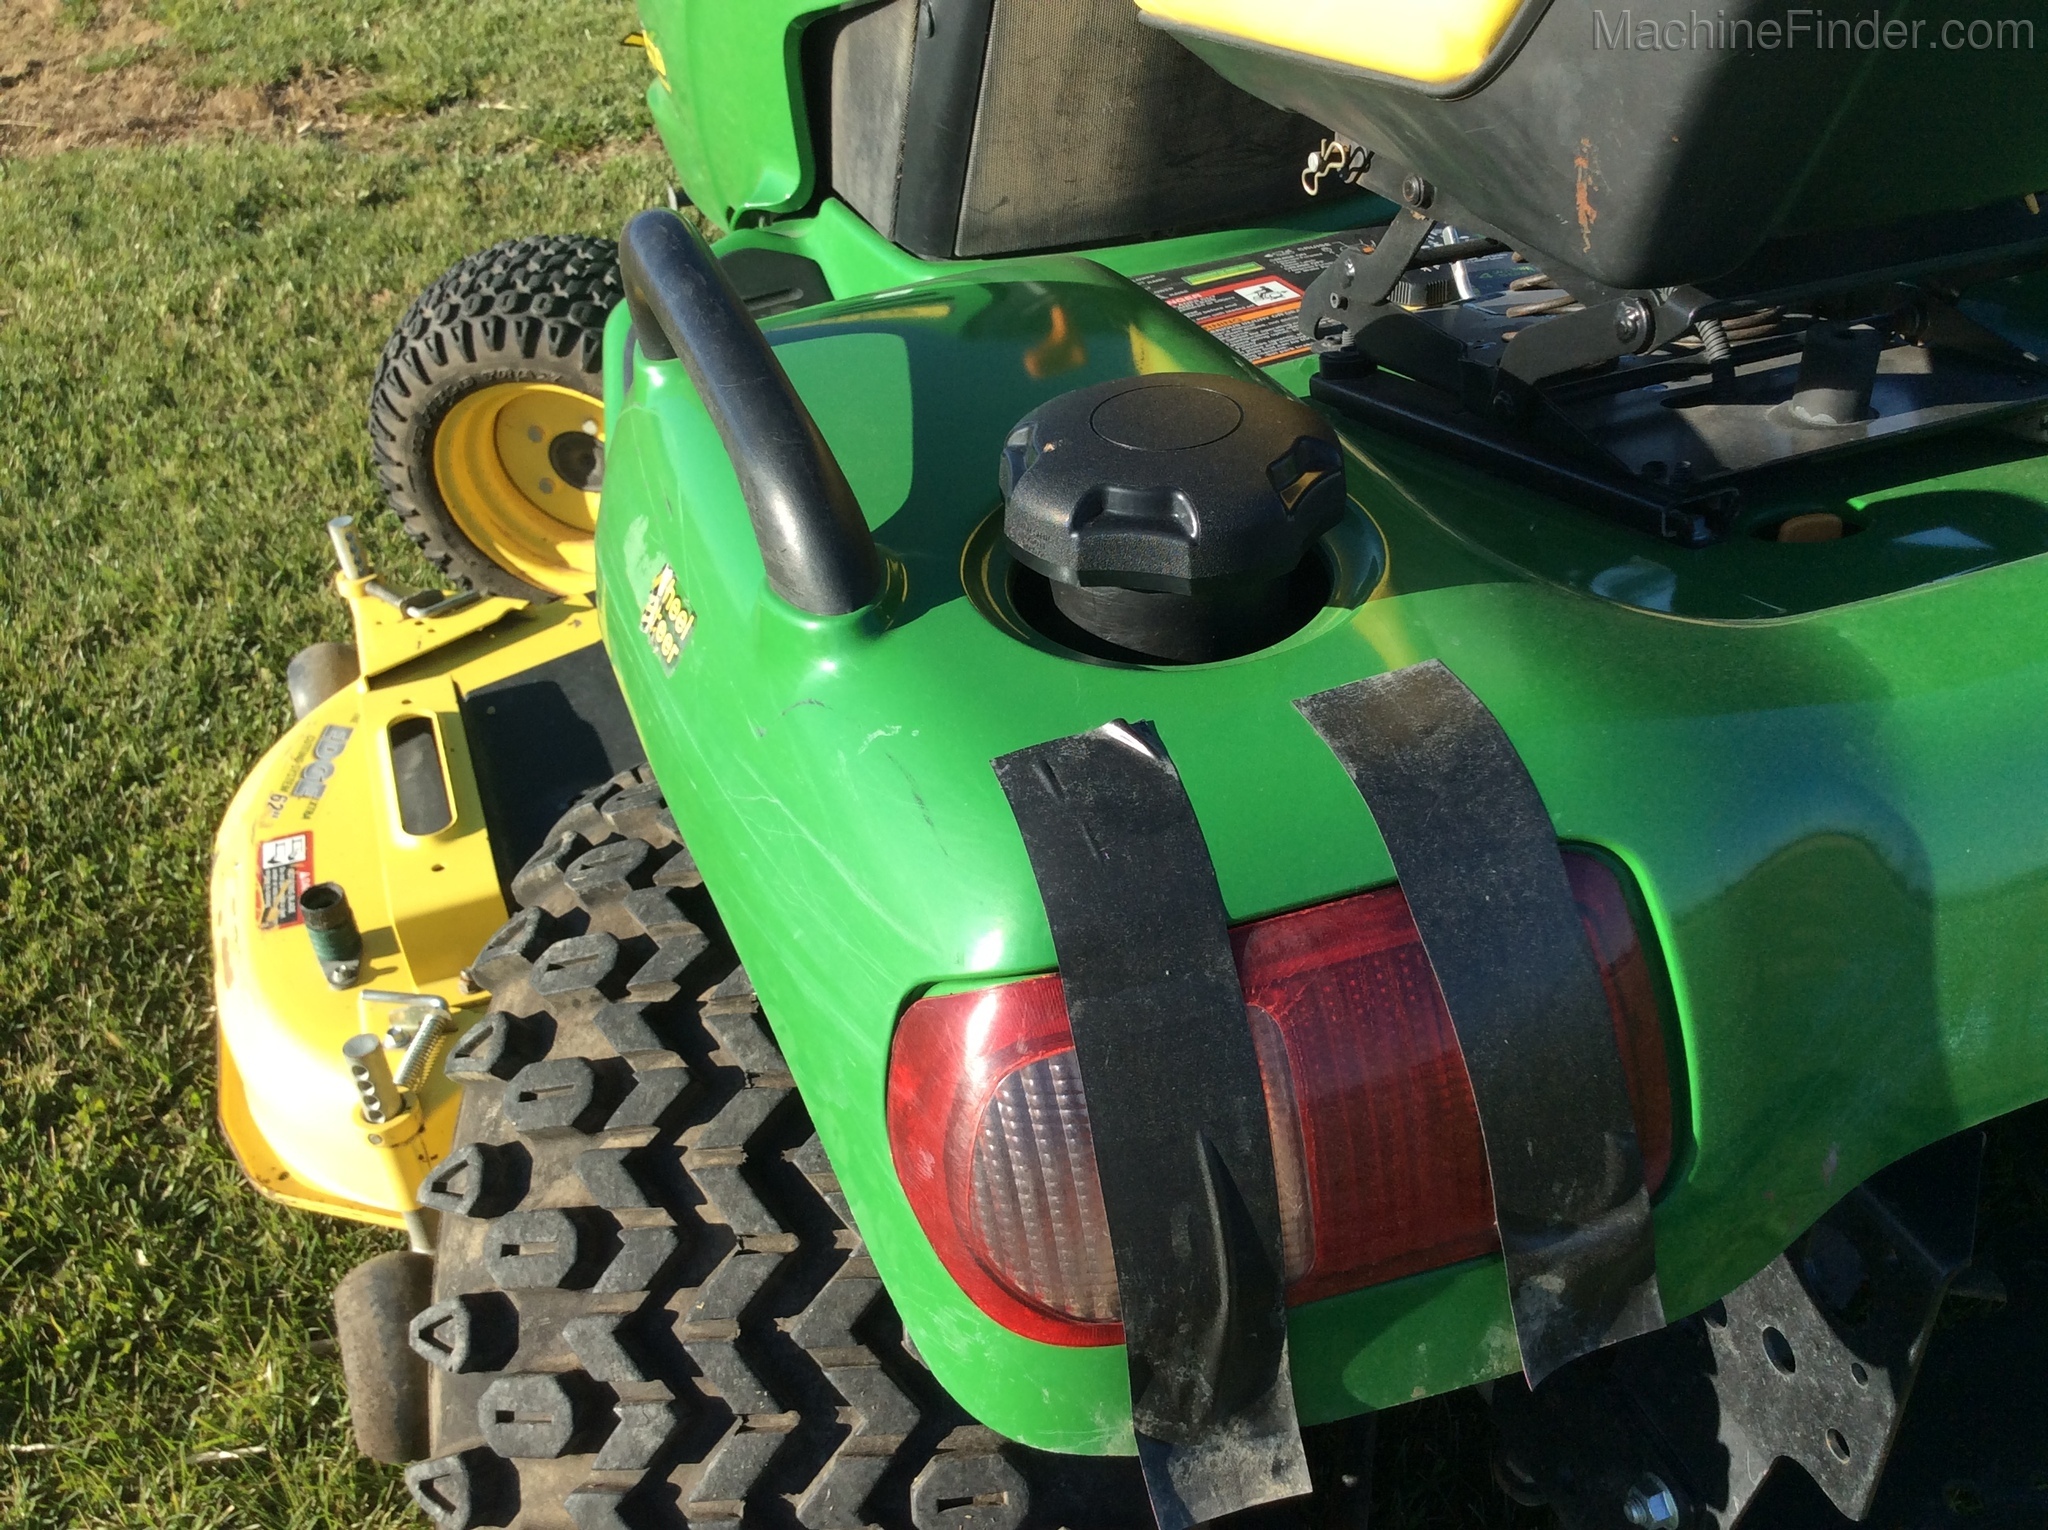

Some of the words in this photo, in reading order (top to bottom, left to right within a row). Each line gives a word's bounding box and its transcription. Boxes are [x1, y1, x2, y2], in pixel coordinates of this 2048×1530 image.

[1165, 293, 1202, 308] NGER
[662, 578, 695, 641] heel
[291, 723, 354, 800] EDGE
